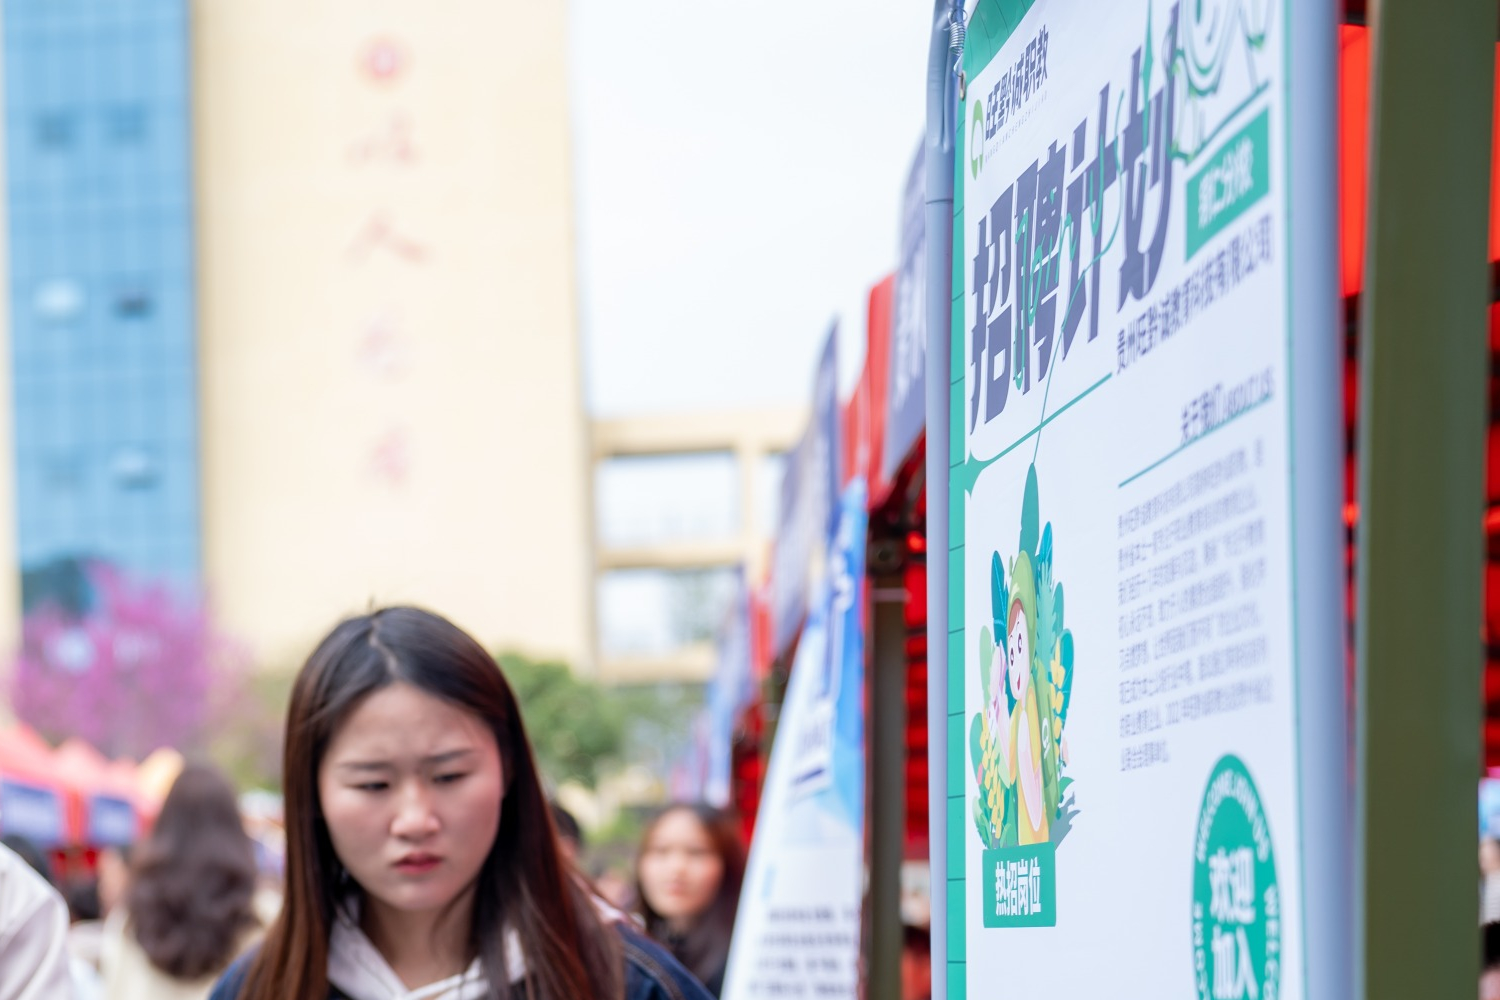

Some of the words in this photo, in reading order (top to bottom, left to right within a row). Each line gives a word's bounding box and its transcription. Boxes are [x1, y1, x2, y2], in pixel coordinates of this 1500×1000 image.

[970, 3, 1181, 435] 招聘计划
[995, 858, 1042, 916] 热招岗位
[1208, 846, 1256, 922] 欢迎
